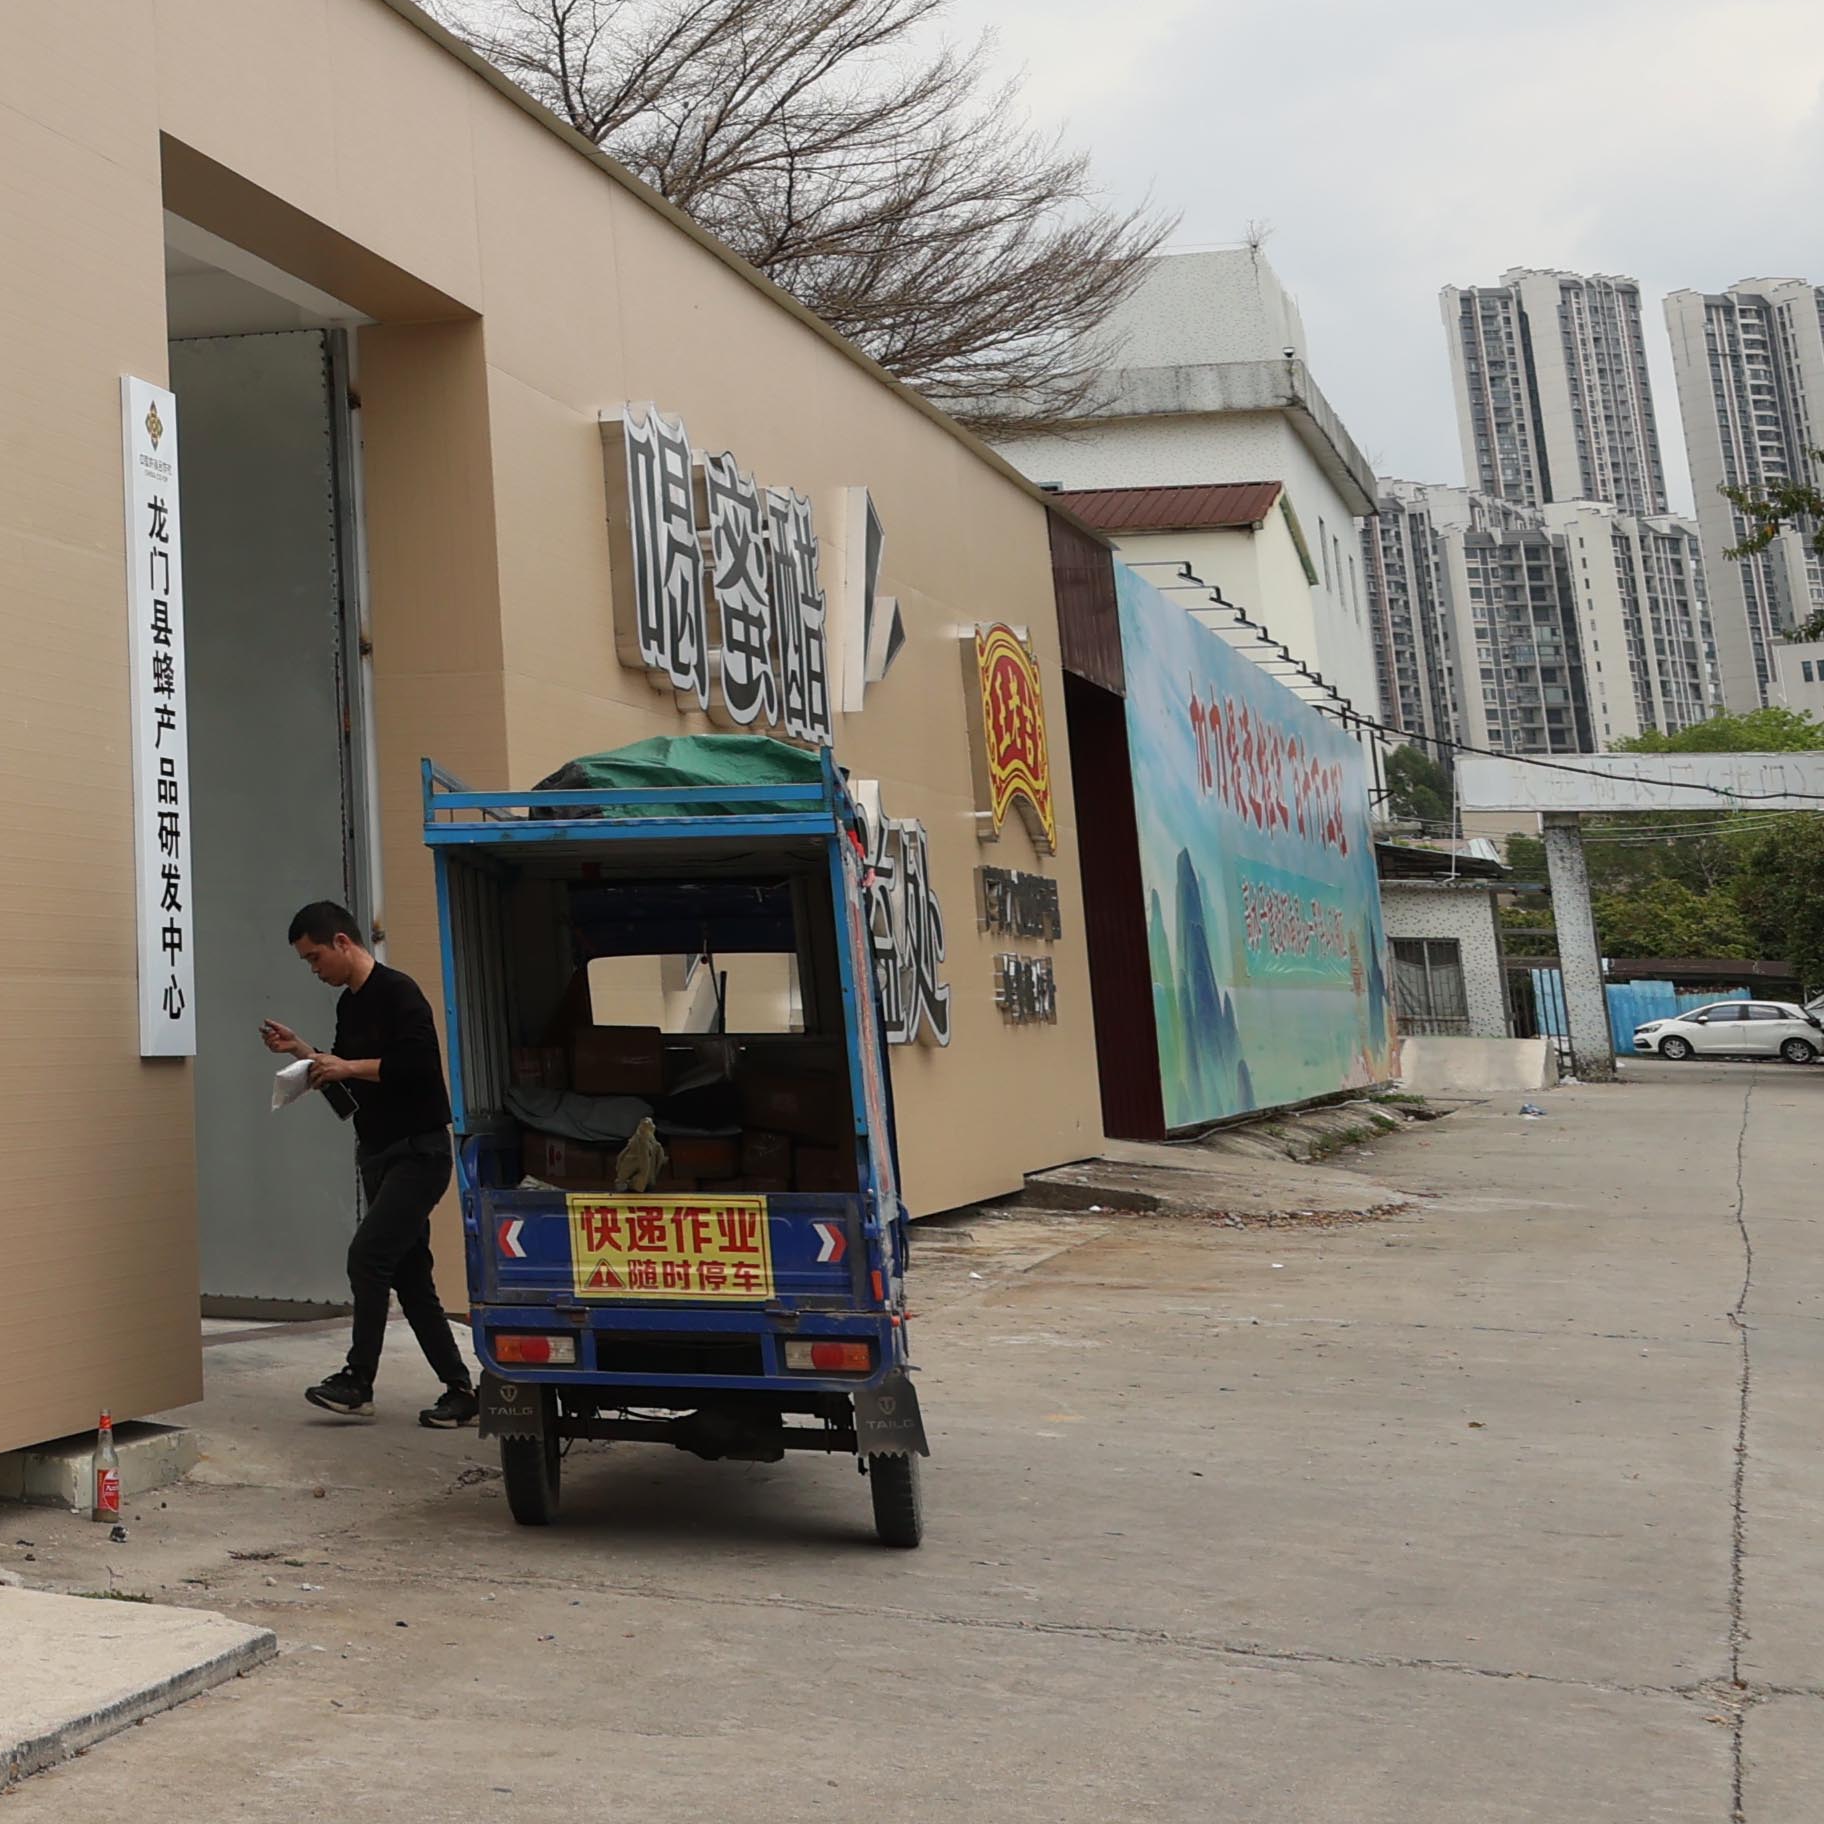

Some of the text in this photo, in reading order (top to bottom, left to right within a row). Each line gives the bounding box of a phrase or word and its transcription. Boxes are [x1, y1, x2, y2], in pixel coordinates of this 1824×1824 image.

[622, 405, 833, 748] 喝蜜醋
[146, 495, 186, 1021] 龙门县蜂产品研发中心
[580, 1205, 760, 1254] 快递作业
[628, 1259, 764, 1293] 随时停车
